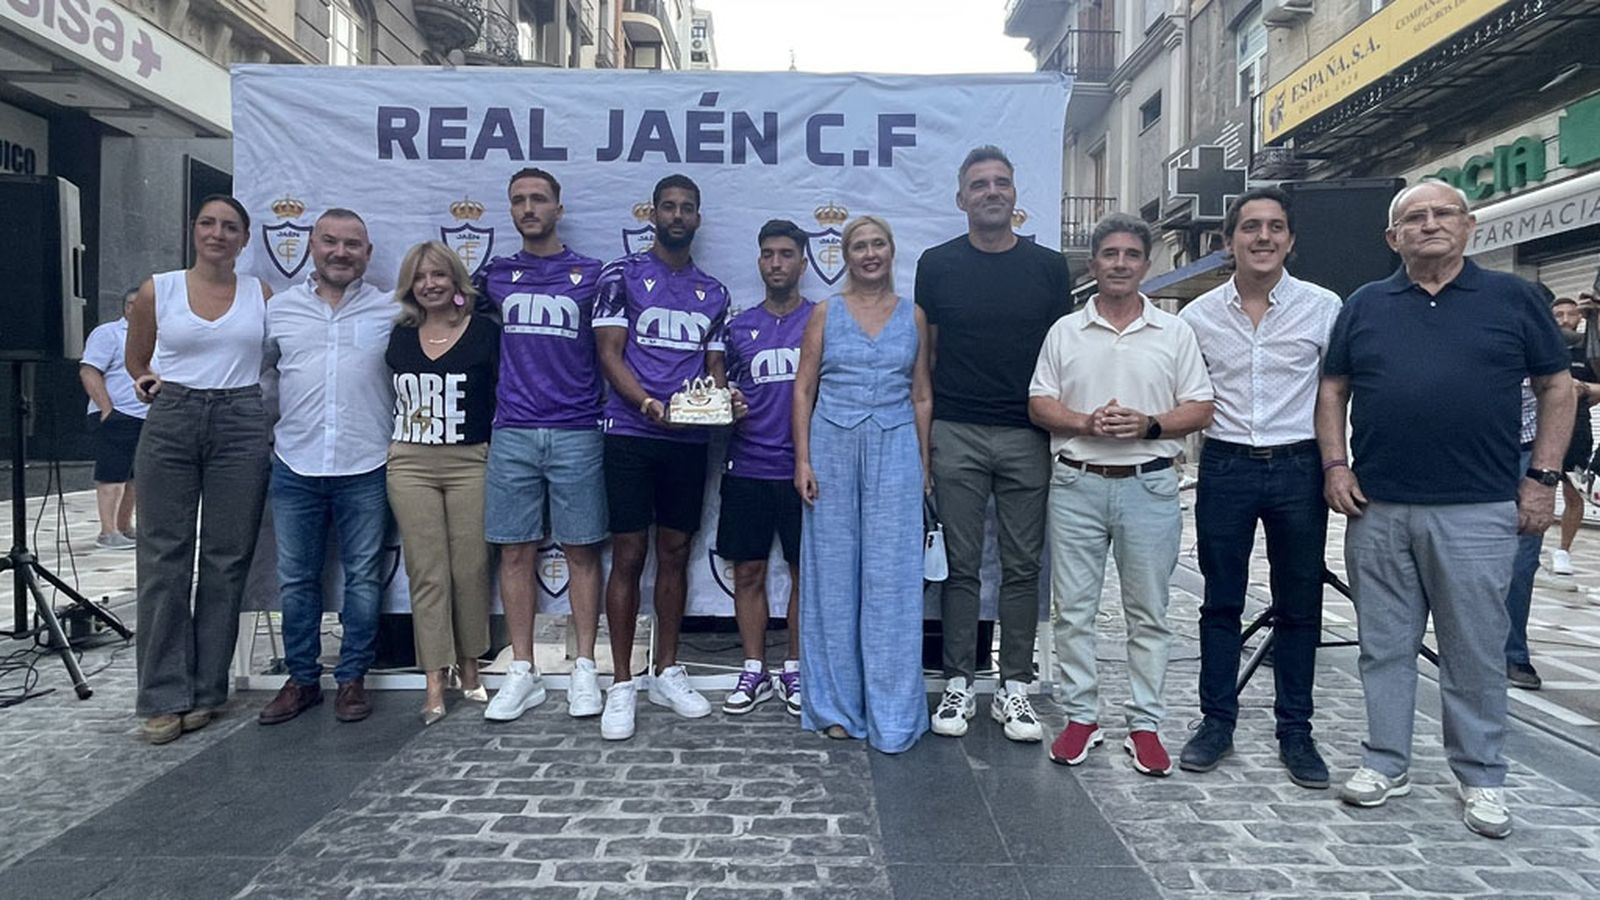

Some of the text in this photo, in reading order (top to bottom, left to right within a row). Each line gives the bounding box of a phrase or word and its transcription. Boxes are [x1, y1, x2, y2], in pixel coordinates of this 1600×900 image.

[377, 92, 917, 168] REAL JAÉN C.F
[1473, 196, 1600, 249] FARMACIA
